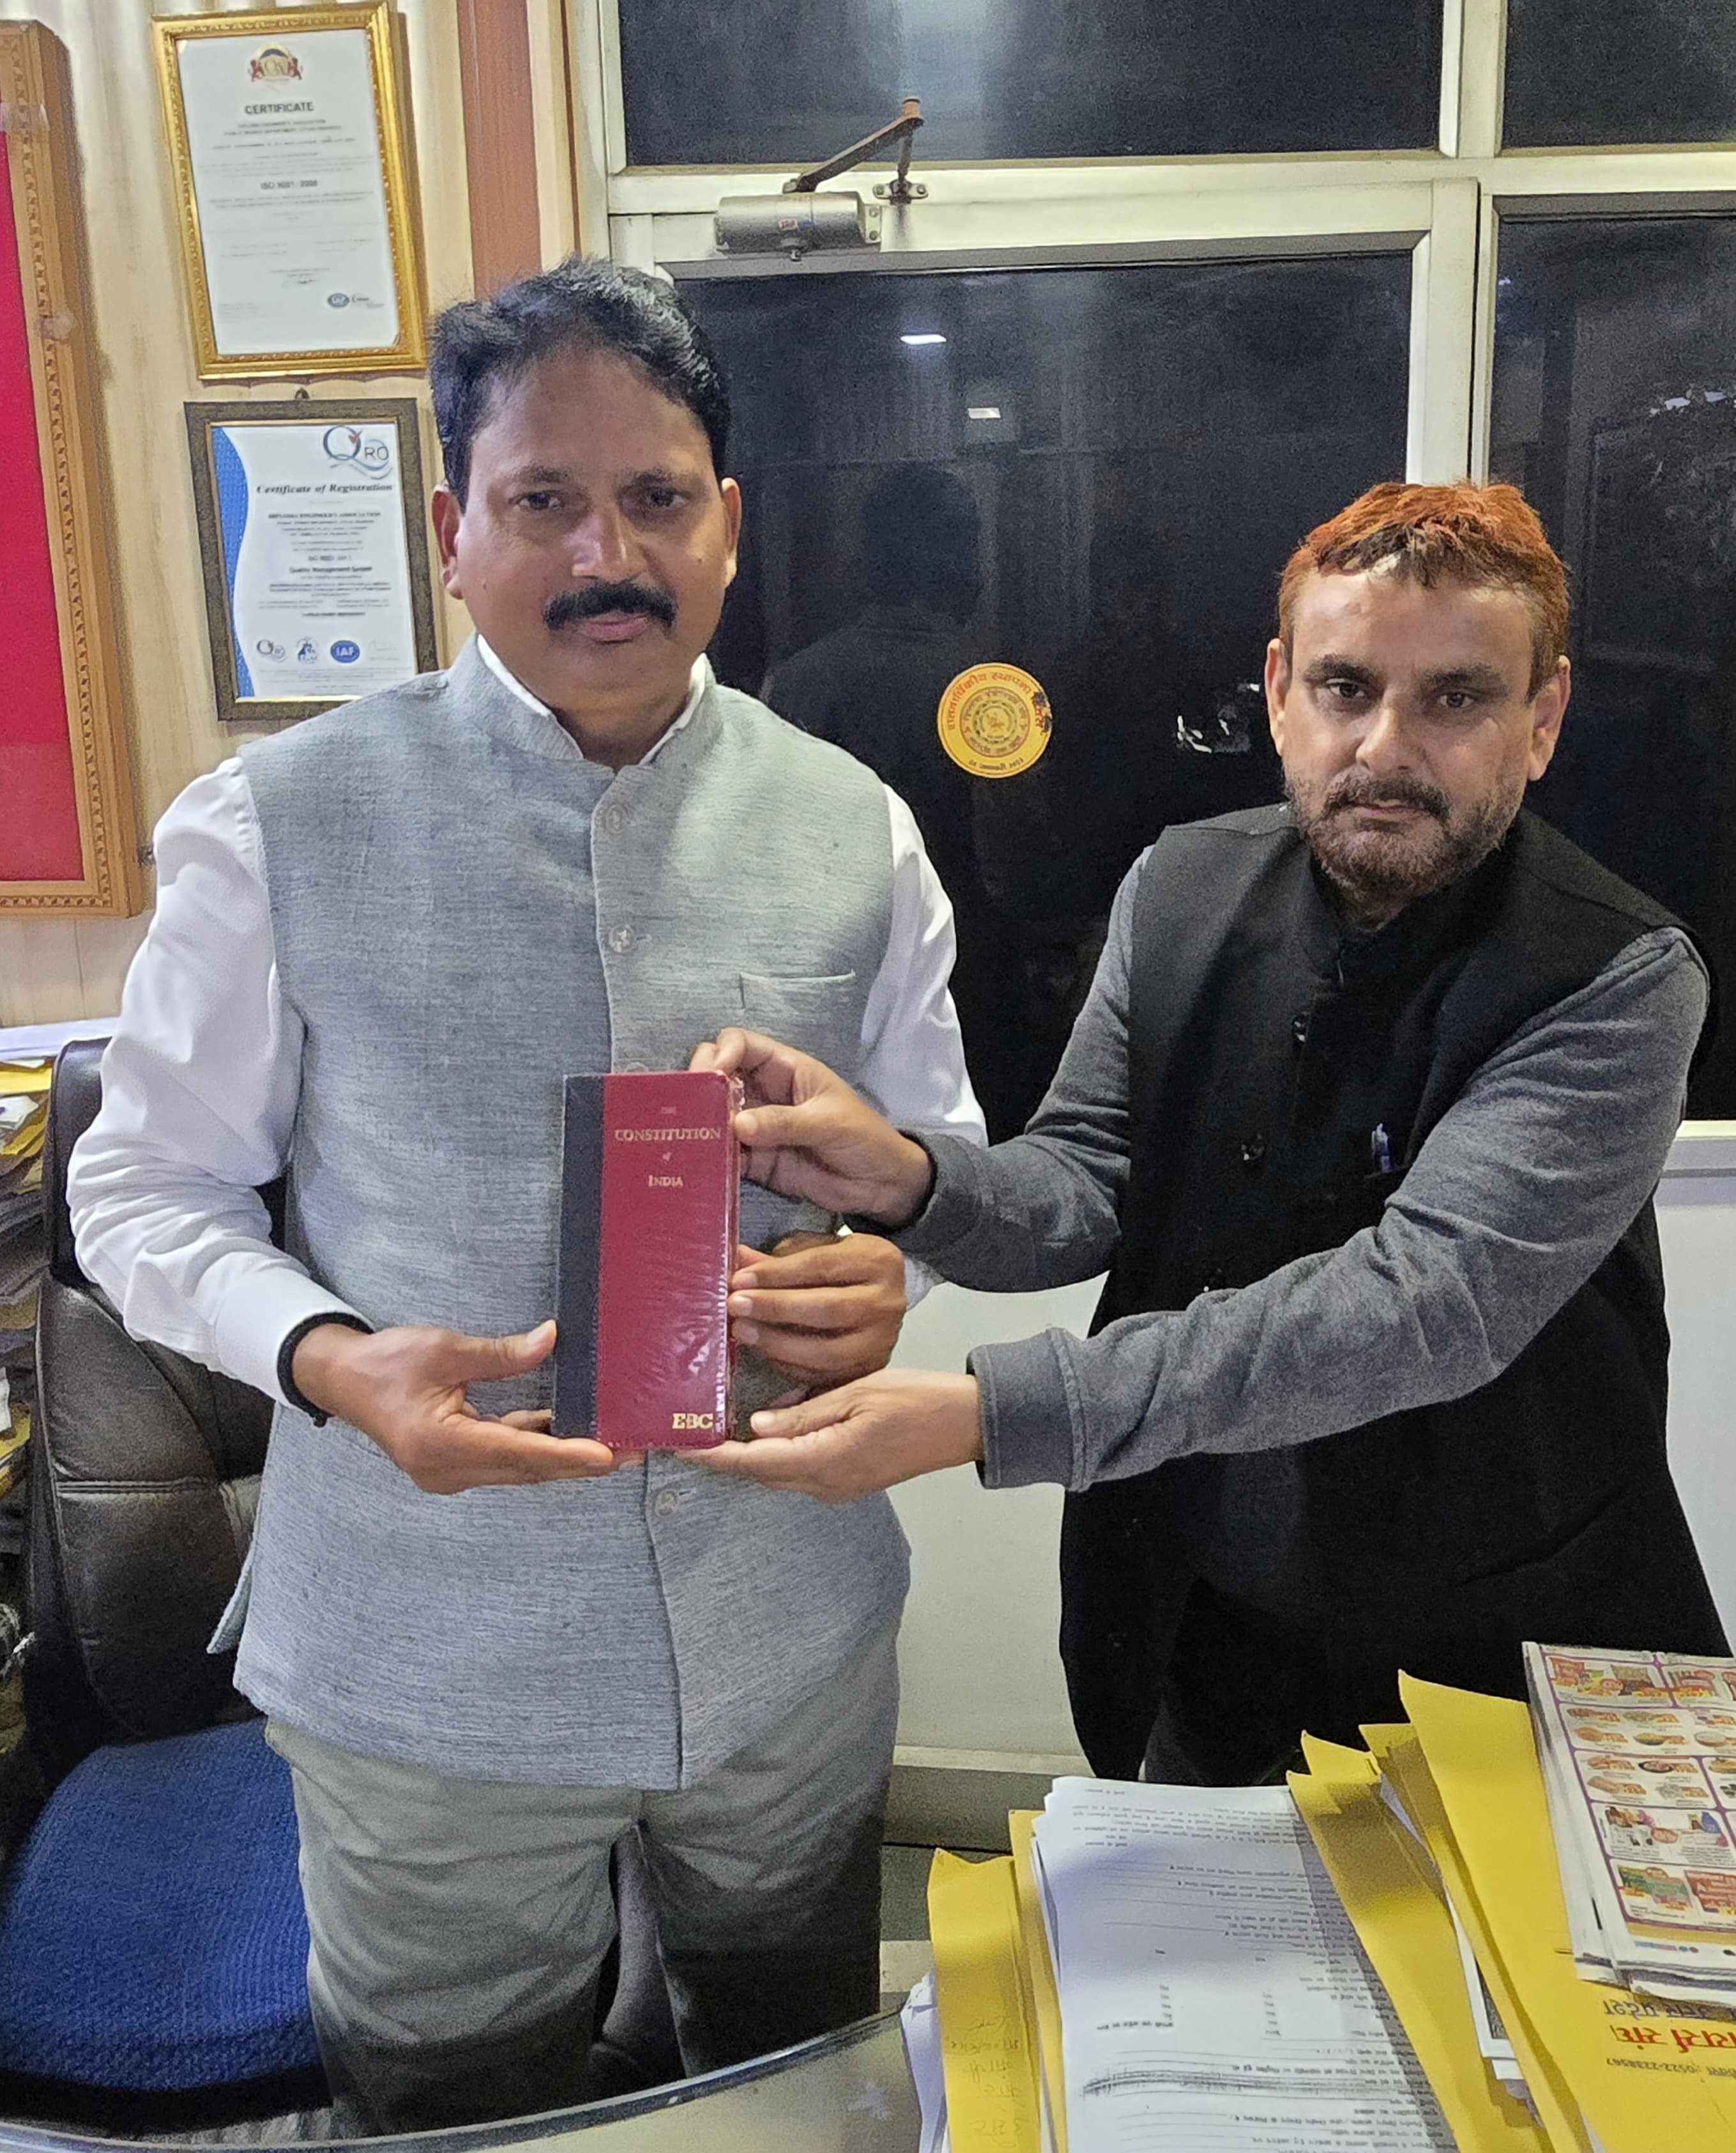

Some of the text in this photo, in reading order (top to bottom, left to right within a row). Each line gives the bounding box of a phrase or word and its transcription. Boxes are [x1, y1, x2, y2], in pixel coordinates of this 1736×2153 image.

[245, 101, 314, 115] CERTIFICATE
[257, 483, 393, 495] Certificate of Registration
[335, 647, 355, 656] IAF
[614, 1127, 722, 1142] CONSTITUTION
[648, 1174, 684, 1188] INDIA
[672, 1413, 714, 1430] EBC
[1603, 1998, 1661, 2021] प्रदेश
[1609, 2025, 1669, 2051] संघ
